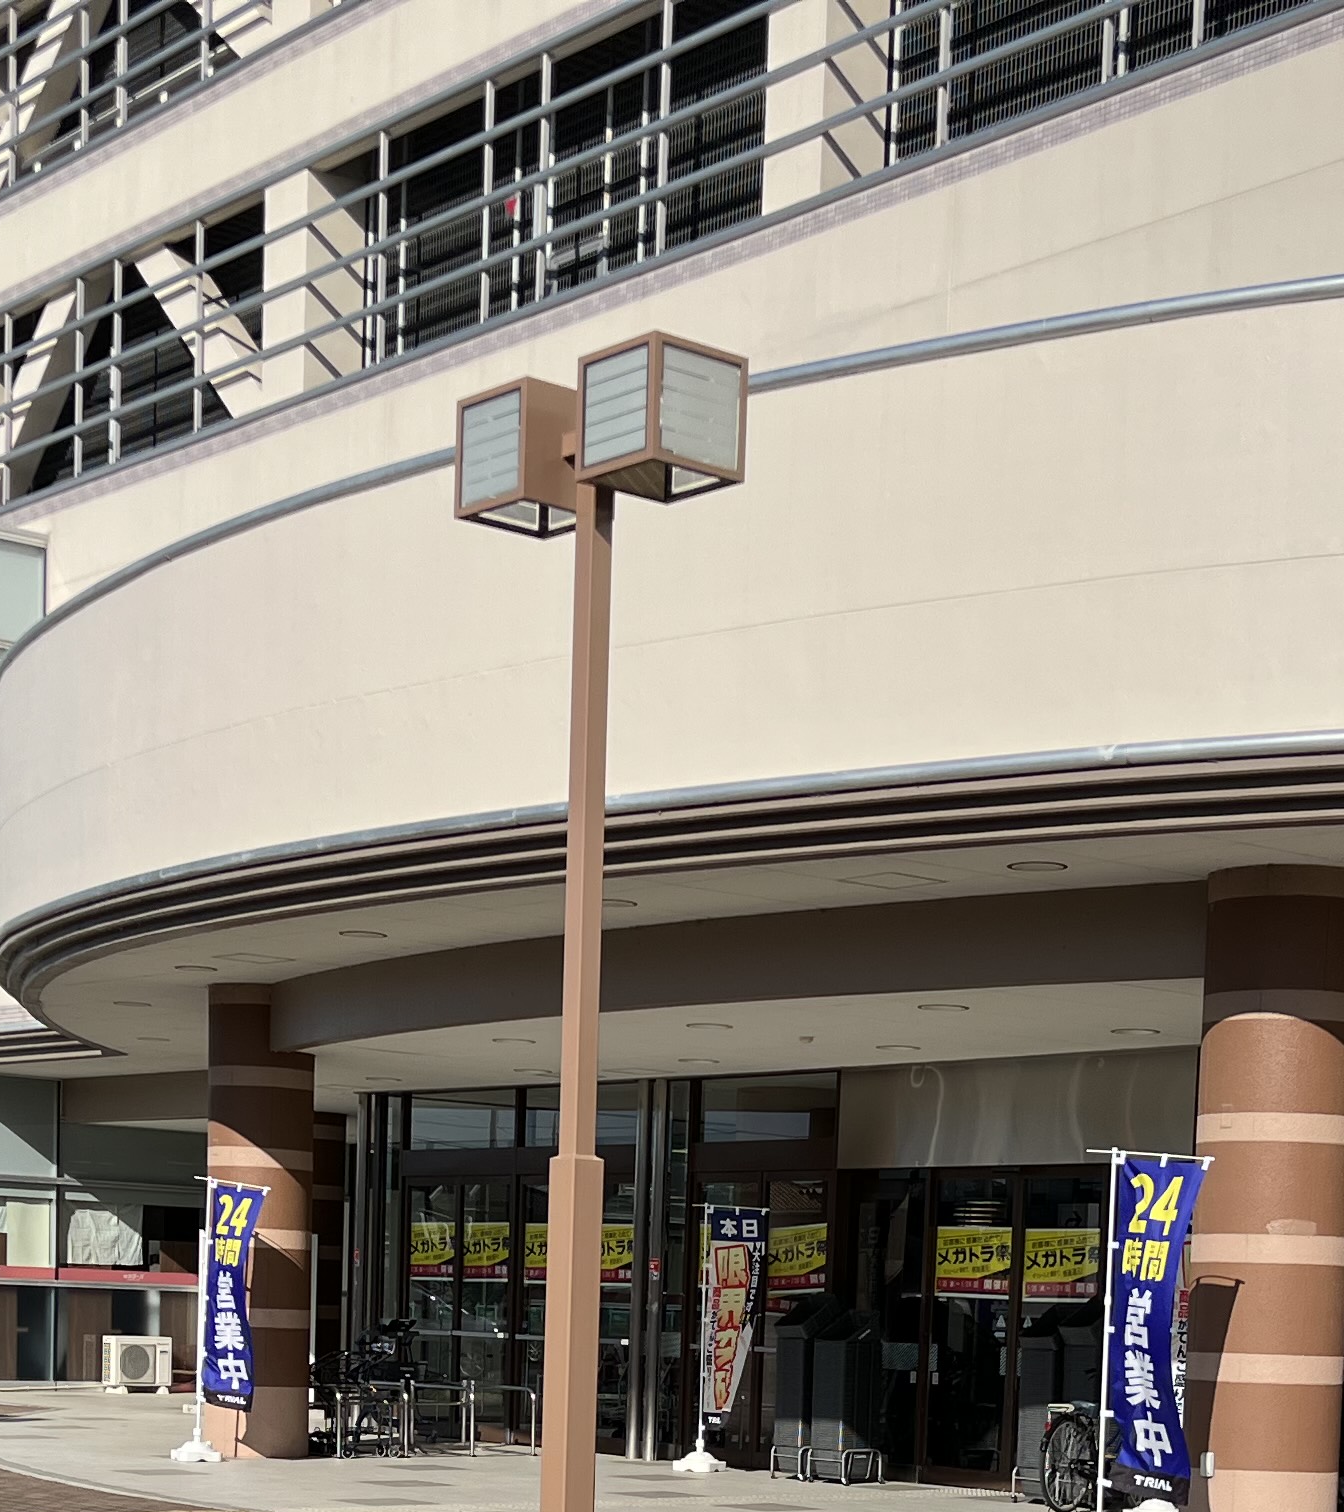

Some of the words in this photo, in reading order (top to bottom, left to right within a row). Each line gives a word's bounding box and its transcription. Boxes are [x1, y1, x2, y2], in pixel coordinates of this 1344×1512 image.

[216, 1194, 253, 1236] 24
[1128, 1173, 1184, 1236] 24
[719, 1217, 759, 1238] 本日
[937, 1243, 1011, 1266] メガトラ祭
[1121, 1237, 1170, 1282] 時間
[213, 1270, 249, 1390] 営業中
[1124, 1287, 1174, 1468] 営業中
[1133, 1474, 1173, 1492] TRIAL
